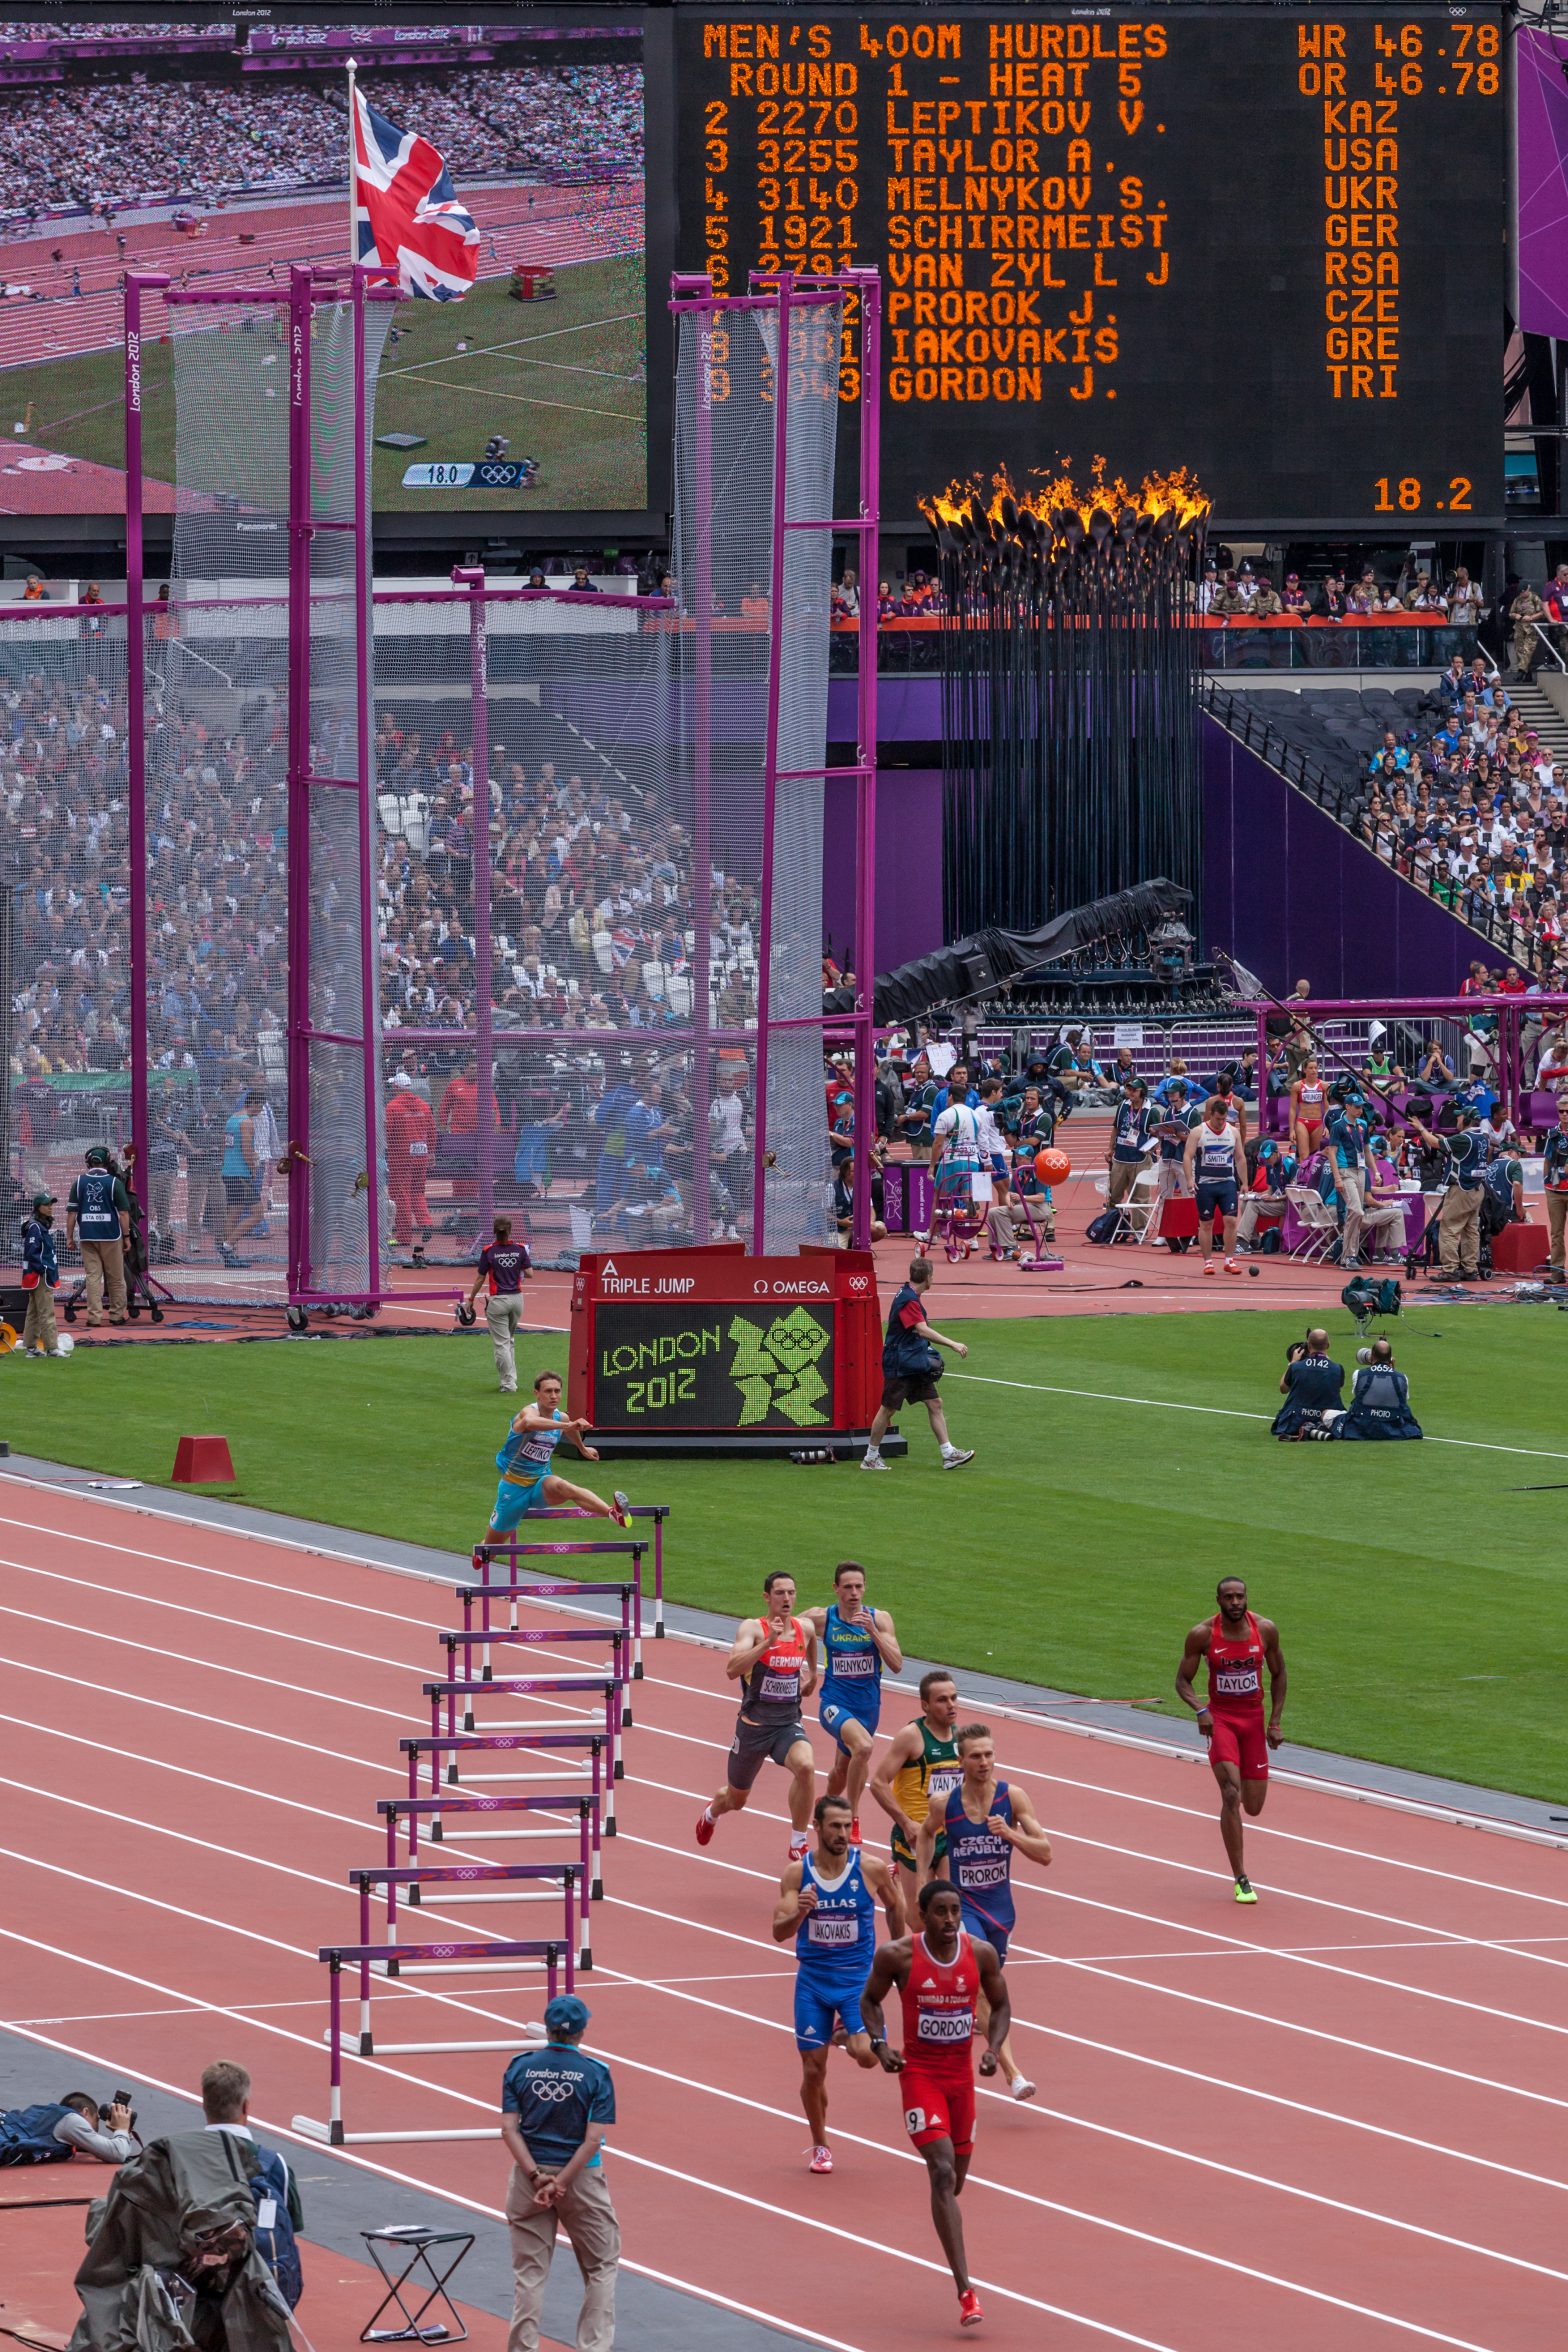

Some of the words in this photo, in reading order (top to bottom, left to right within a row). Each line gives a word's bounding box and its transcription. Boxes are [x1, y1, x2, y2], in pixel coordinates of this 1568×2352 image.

[232, 9, 255, 17] London
[704, 24, 832, 59] MEN'S
[860, 24, 961, 59] 400M
[990, 24, 1168, 59] HURDLES
[1298, 24, 1347, 58] WR
[730, 62, 858, 97] ROUND
[887, 62, 909, 97] 1
[989, 62, 1090, 97] HEAT
[1118, 62, 1143, 98] 5
[1298, 62, 1347, 96] OR
[704, 100, 729, 135] 2
[756, 100, 858, 136] 2270
[887, 99, 1092, 135] LEPTIKOV
[1324, 100, 1398, 134] KAZ
[705, 138, 729, 173] 3
[757, 138, 859, 173] 3255
[887, 138, 1040, 174] TAYLOR
[1324, 138, 1399, 172] USA
[705, 177, 729, 211] 4
[757, 177, 859, 211] 3140
[887, 176, 1092, 212] MELNYKOV
[1324, 176, 1399, 210] UKR
[705, 215, 729, 250] 5
[758, 215, 858, 250] 1921
[887, 213, 1169, 250] SCHIRRMEIST
[1325, 213, 1399, 247] GER
[705, 253, 730, 287] 6
[887, 252, 964, 288] VAN
[990, 252, 1067, 288] ZYL
[1093, 252, 1118, 287] L
[1145, 251, 1169, 286] J
[1325, 251, 1399, 285] RSA
[888, 290, 1042, 326] PROROK
[1325, 289, 1399, 323] CZE
[128, 331, 140, 360] 2012
[890, 328, 1119, 365] IAKOVAKIS
[1325, 327, 1400, 361] GRE
[129, 363, 141, 412] London
[888, 365, 1042, 402] GORDON
[1326, 364, 1398, 398] TRI
[427, 465, 457, 483] 18.0
[1207, 1155, 1226, 1163] SMITH
[602, 1258, 618, 1276] A
[601, 1278, 650, 1294] TRIPLE
[654, 1278, 695, 1294] JUMP
[773, 1280, 831, 1294] OMEGA
[602, 1324, 720, 1377] LONDON
[1305, 1358, 1329, 1369] 0142
[1370, 1363, 1394, 1373] 0652
[626, 1368, 696, 1413] 2012
[1301, 1408, 1322, 1418] PHOTO
[1370, 1409, 1391, 1418] PHOTO
[832, 1633, 872, 1642] UKRAINE
[834, 1658, 873, 1673] MELNYKOV
[1221, 1656, 1255, 1669] USA
[1218, 1675, 1257, 1690] TAYLOR
[827, 1708, 835, 1719] 4
[932, 1776, 949, 1791] VAN
[953, 1844, 1010, 1858] REPUBLIC
[959, 1835, 1002, 1847] CZECH
[961, 1865, 1006, 1884] PROROK
[814, 1923, 851, 1940] IAKOVAKIS
[920, 2018, 971, 2037] GORDON
[525, 2068, 560, 2079] London
[560, 2070, 584, 2081] 2012
[909, 2111, 918, 2131] 9
